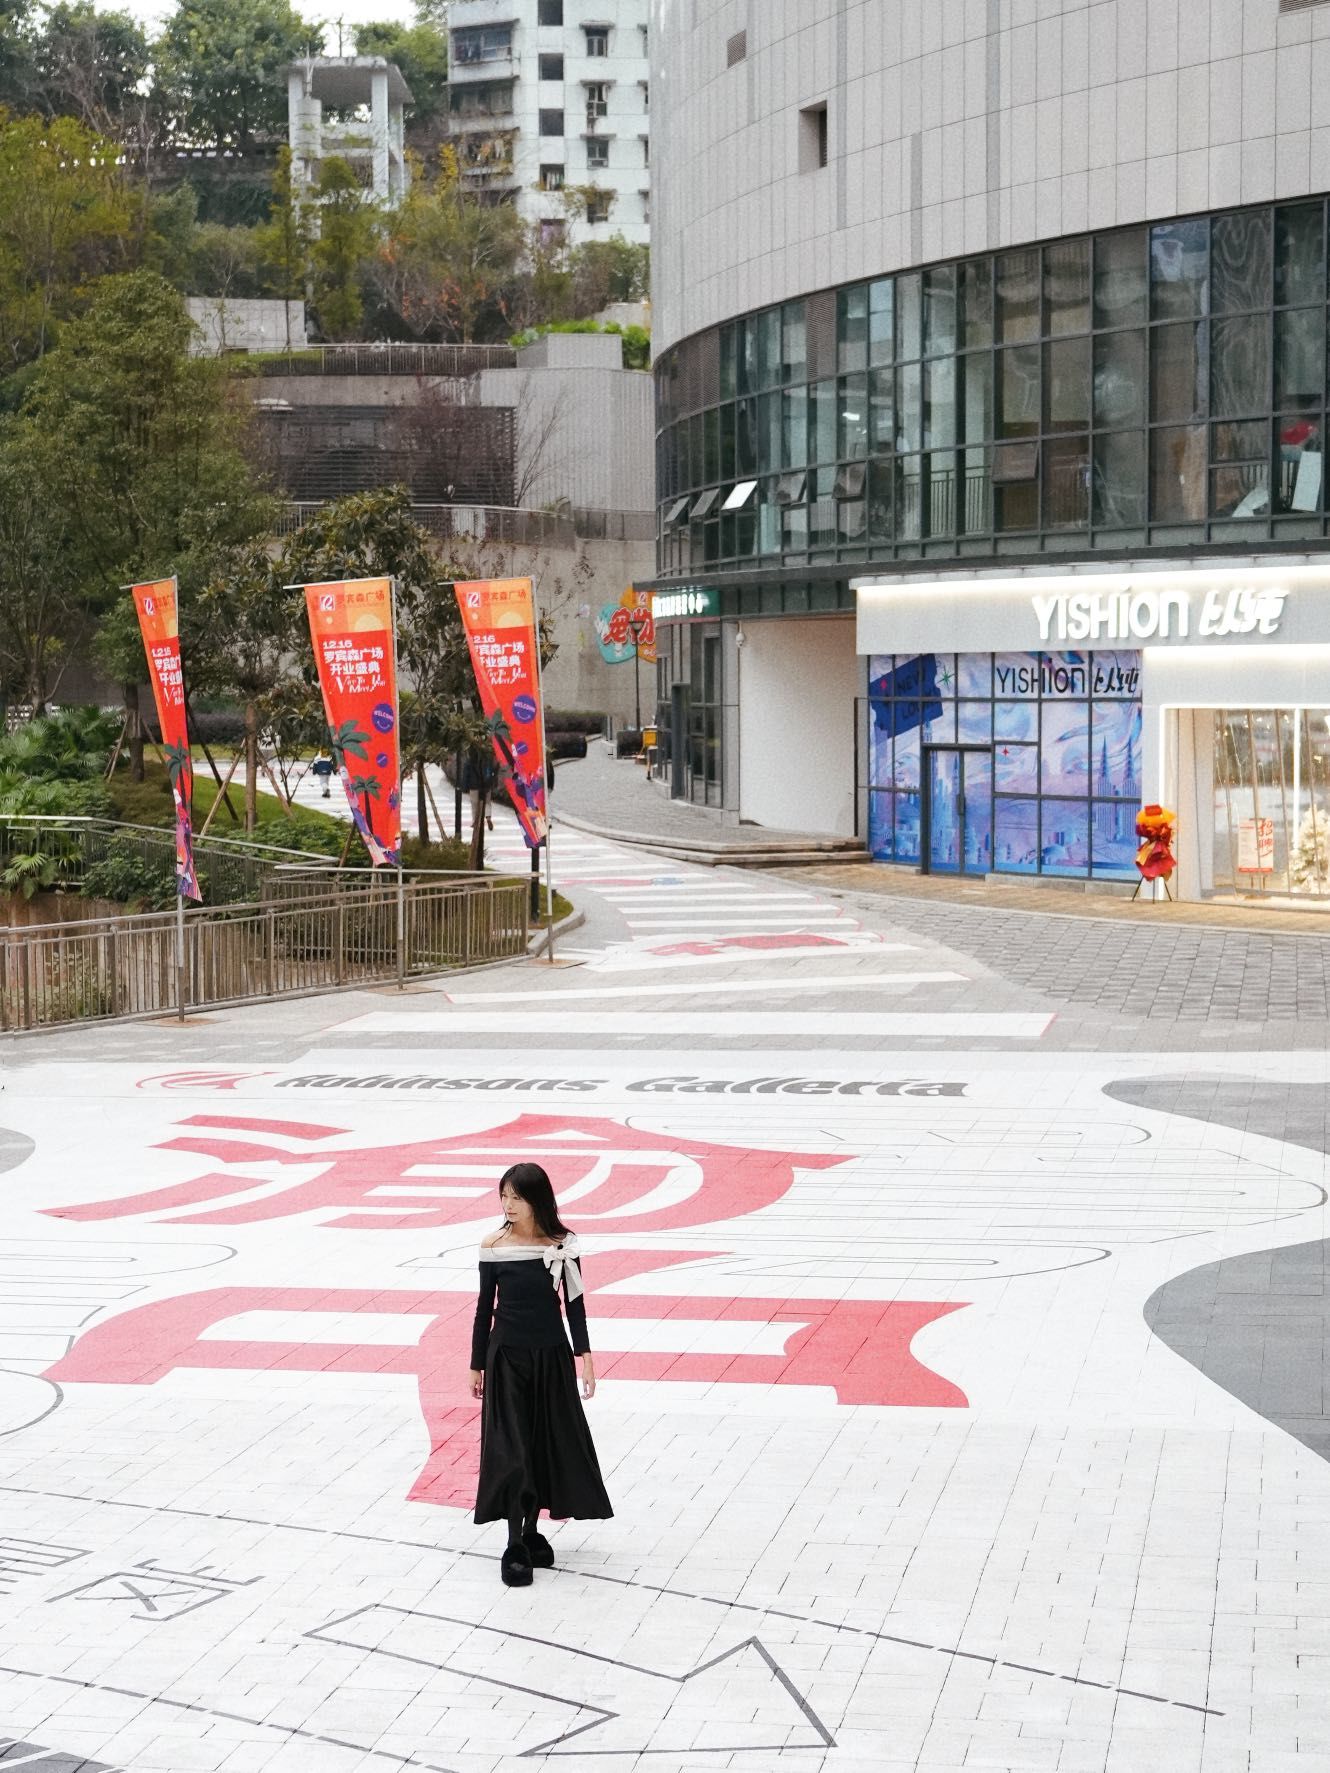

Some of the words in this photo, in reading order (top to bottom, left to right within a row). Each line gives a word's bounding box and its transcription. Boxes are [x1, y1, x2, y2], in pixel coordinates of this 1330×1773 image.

[1031, 588, 1190, 640] YISHION
[322, 640, 353, 650] 12.16
[323, 647, 384, 664] 罗宾森广场
[330, 661, 381, 677] 开业盛典
[996, 667, 1086, 694] YISHION
[273, 1073, 611, 1092] Robinsons
[625, 1075, 970, 1097] Galleria
